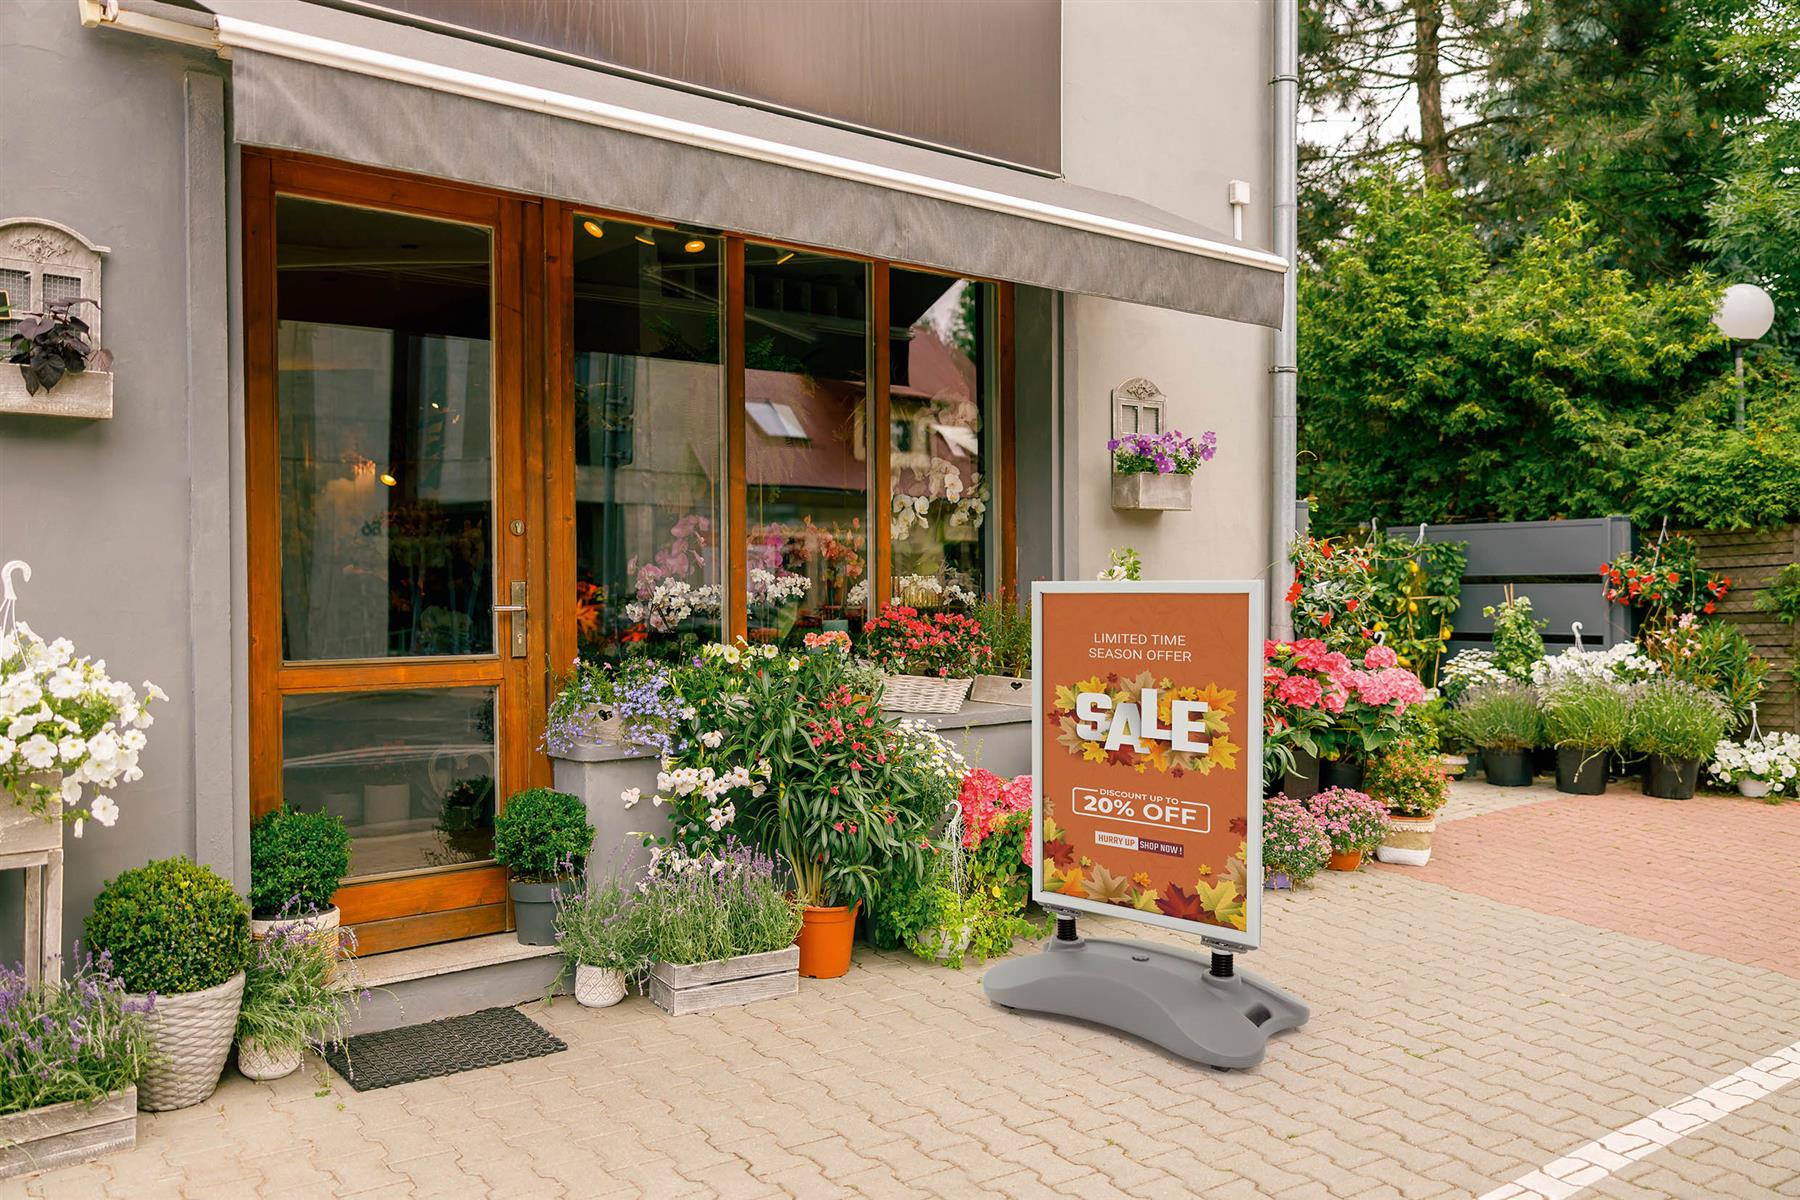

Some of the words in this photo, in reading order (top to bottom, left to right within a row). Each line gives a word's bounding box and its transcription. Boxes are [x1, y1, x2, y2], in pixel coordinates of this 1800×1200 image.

[1094, 632, 1147, 645] LIMITED
[1151, 634, 1186, 646] TIME
[1088, 647, 1143, 660] SEASON
[1146, 649, 1192, 662] OFFER
[1076, 687, 1209, 754] SALE
[1100, 788, 1147, 801] DISCOUNT
[1149, 794, 1163, 803] UP
[1166, 796, 1179, 805] TO
[1083, 795, 1135, 817] 20%
[1143, 803, 1197, 825] OFF
[1098, 834, 1123, 846] HURRY
[1125, 837, 1136, 847] UP
[1139, 840, 1159, 850] SHOP
